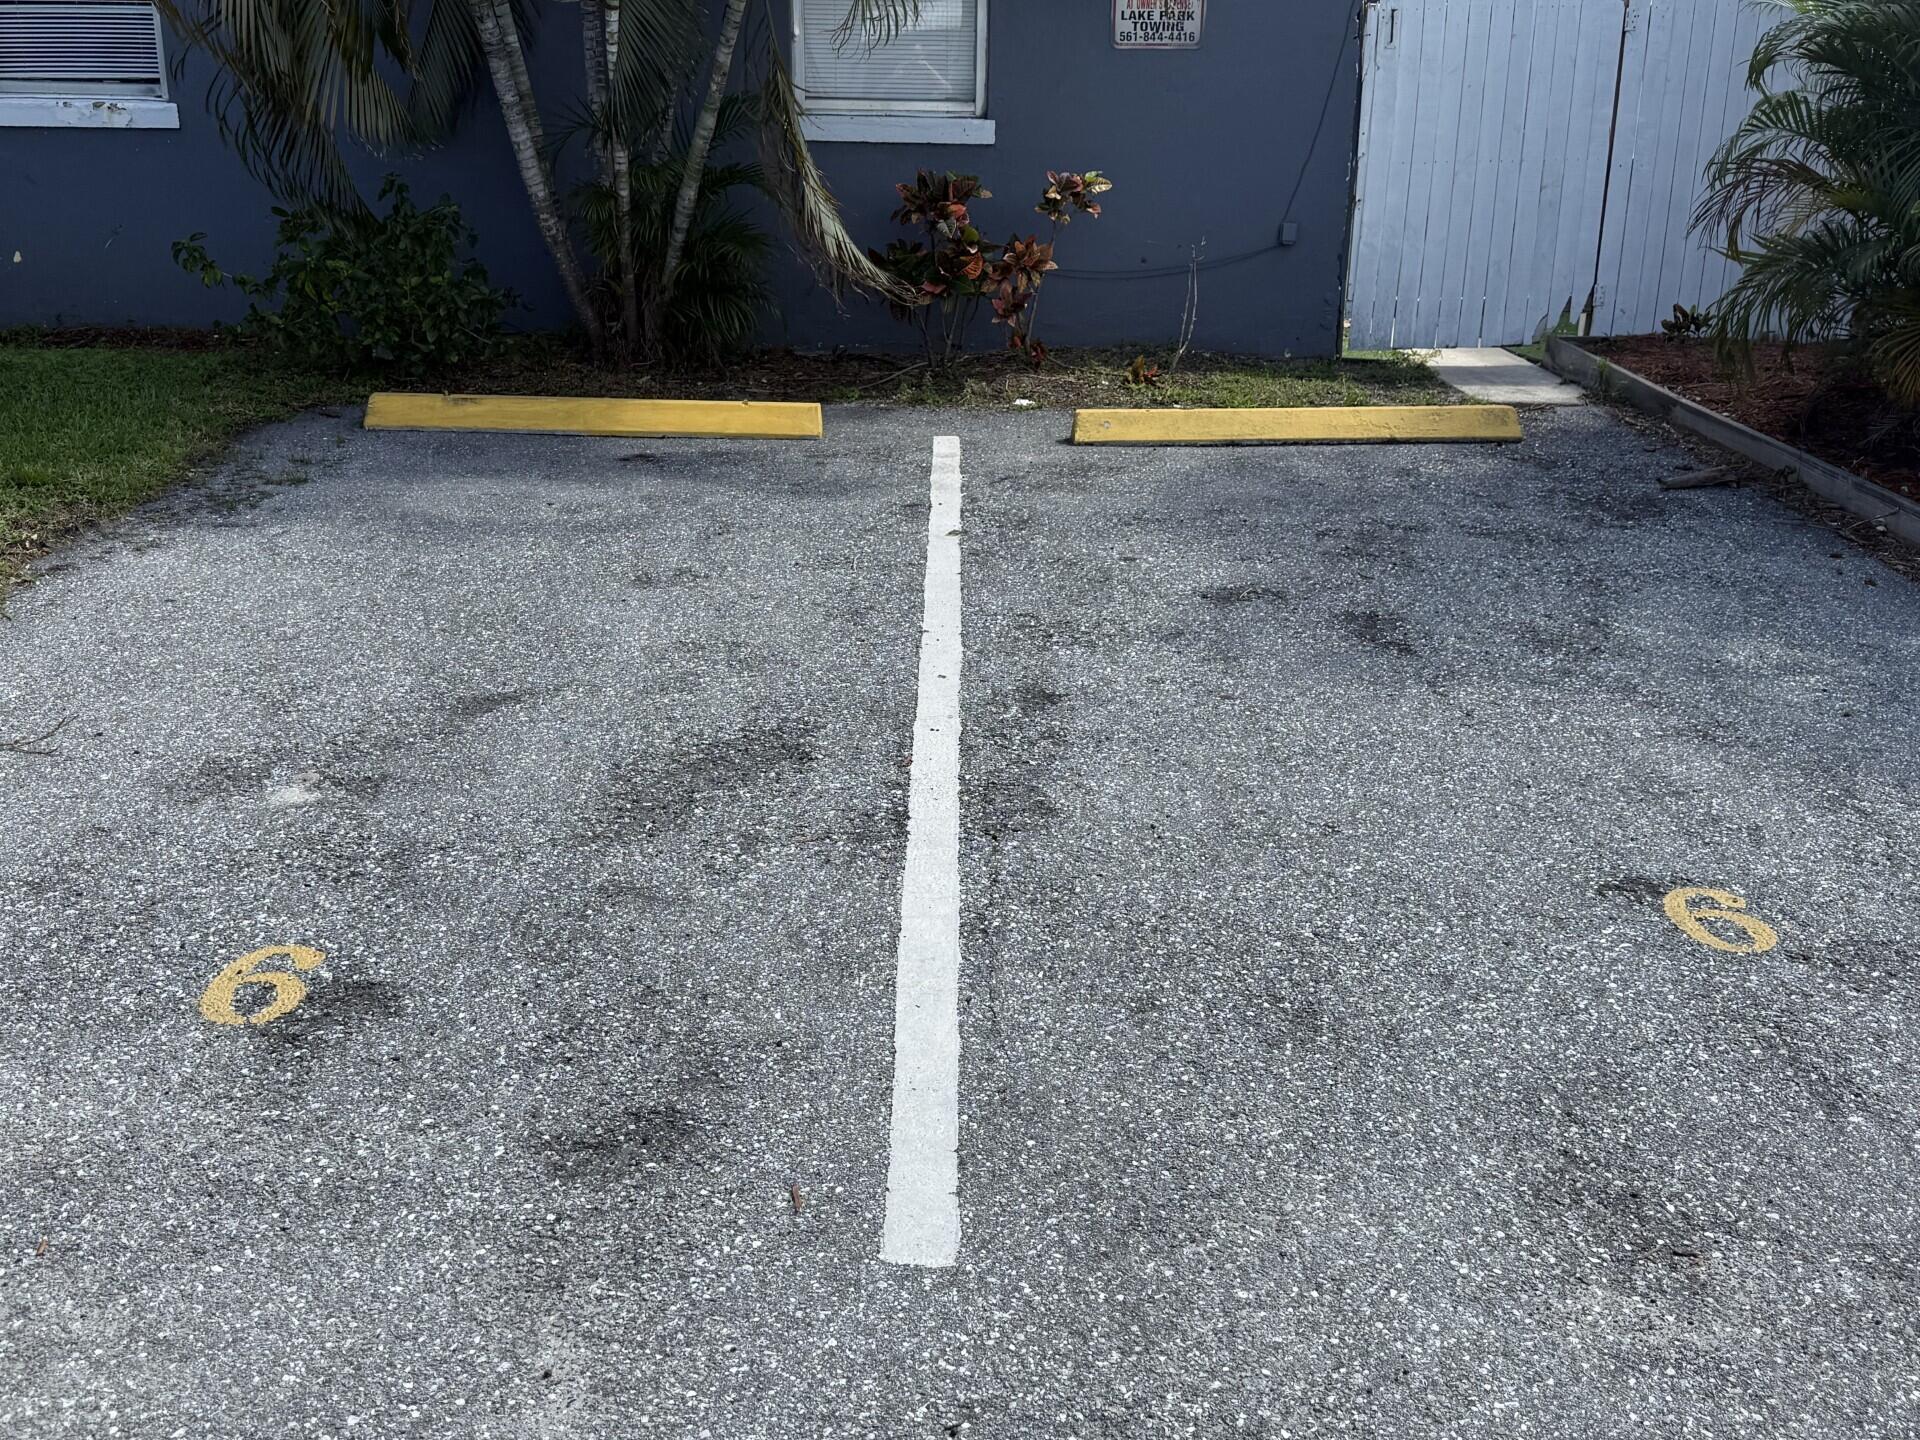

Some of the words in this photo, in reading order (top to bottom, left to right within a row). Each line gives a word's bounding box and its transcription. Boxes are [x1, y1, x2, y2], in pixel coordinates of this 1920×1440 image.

[1121, 10, 1154, 20] LAKE
[1160, 10, 1195, 20] PARK
[1132, 21, 1184, 32] TOWING
[1120, 32, 1195, 42] 561-844-4416
[1663, 887, 1777, 953] 6
[200, 944, 326, 1025] 6
